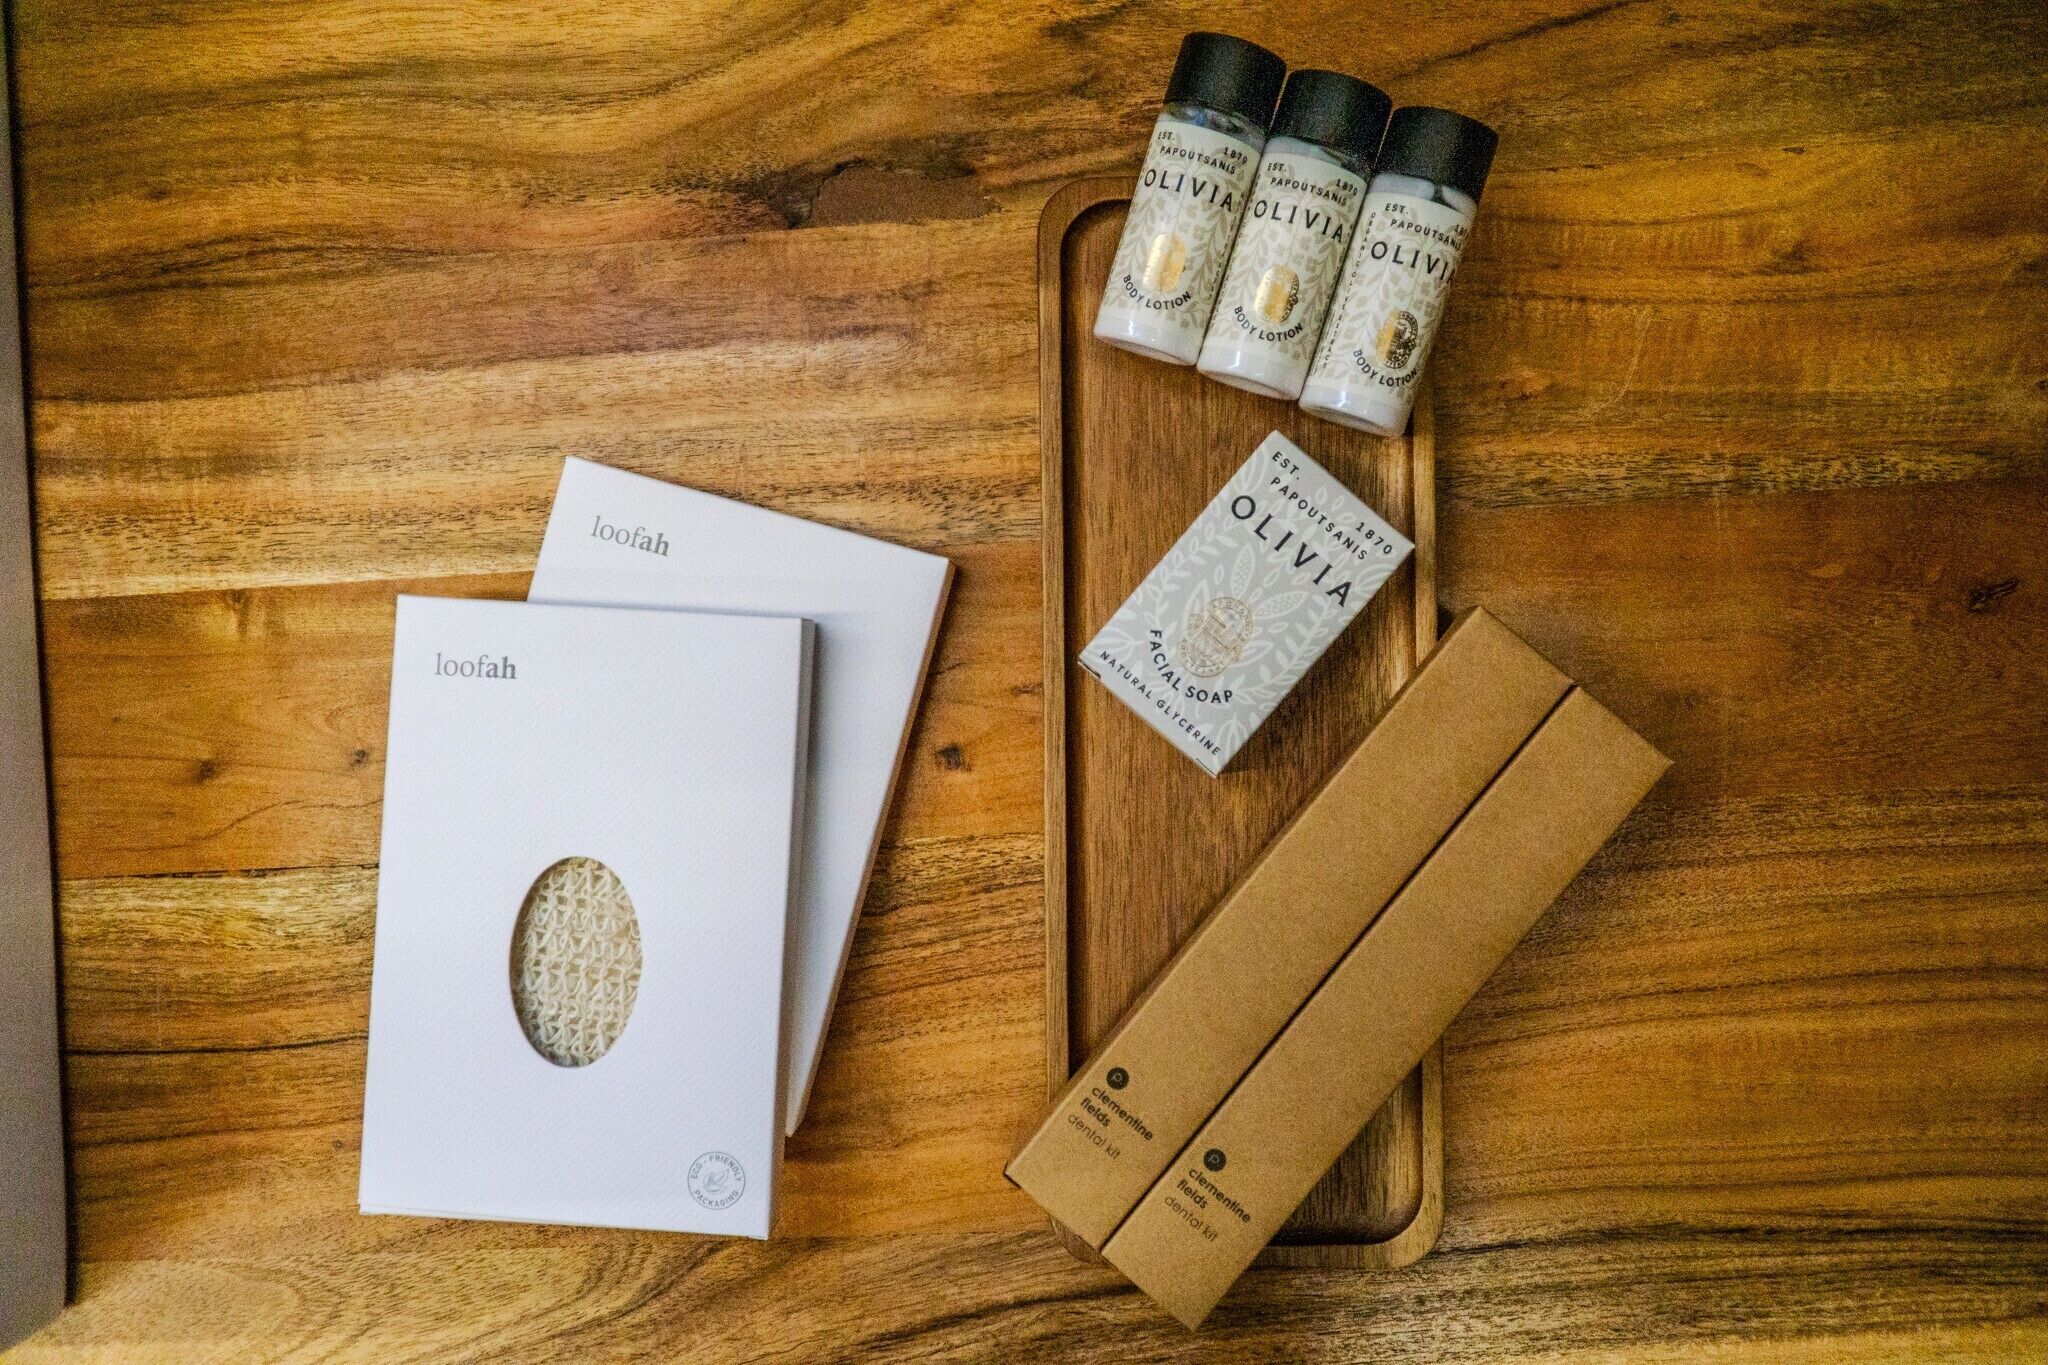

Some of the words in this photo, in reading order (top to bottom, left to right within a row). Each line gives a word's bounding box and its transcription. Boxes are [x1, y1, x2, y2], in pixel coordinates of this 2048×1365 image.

[1158, 131, 1175, 140] EST.
[1223, 147, 1248, 164] 1870
[1160, 146, 1236, 175] PAPOUTSANIS
[1144, 169, 1232, 212] OLIVIA
[1267, 163, 1287, 172] EST.
[1335, 178, 1358, 197] 1870
[1271, 177, 1348, 207] PAPOUTSANIS
[1254, 199, 1343, 243] OLIVIA
[1385, 203, 1409, 214] EST.
[1123, 275, 1144, 303] BODY
[1146, 291, 1192, 310] LOTION
[1234, 306, 1257, 334] BODY
[1258, 323, 1303, 342] LOTION
[1353, 350, 1377, 380] BODY
[1379, 368, 1418, 387] LOTION
[1271, 477, 1368, 560] PAPOUTSANIS
[1272, 451, 1300, 480] EST.
[1355, 521, 1393, 556] 1870
[590, 515, 670, 557] loofah
[1231, 495, 1352, 608] OLIVIA
[433, 652, 517, 680] loofah
[1149, 629, 1181, 691] FACIAL
[1185, 686, 1234, 705] SOAP
[1100, 651, 1153, 699] NATURAL
[1156, 699, 1221, 756] GLYCERINE
[1080, 1097, 1111, 1128] fields
[1091, 1086, 1153, 1142] clementine
[1068, 1113, 1107, 1149] dental
[1105, 1144, 1121, 1160] kit
[694, 1189, 739, 1207] PACKAGING
[1176, 1179, 1208, 1210] fields
[1188, 1168, 1251, 1224] clementine
[1165, 1196, 1204, 1231] dental
[1202, 1226, 1218, 1243] kit
